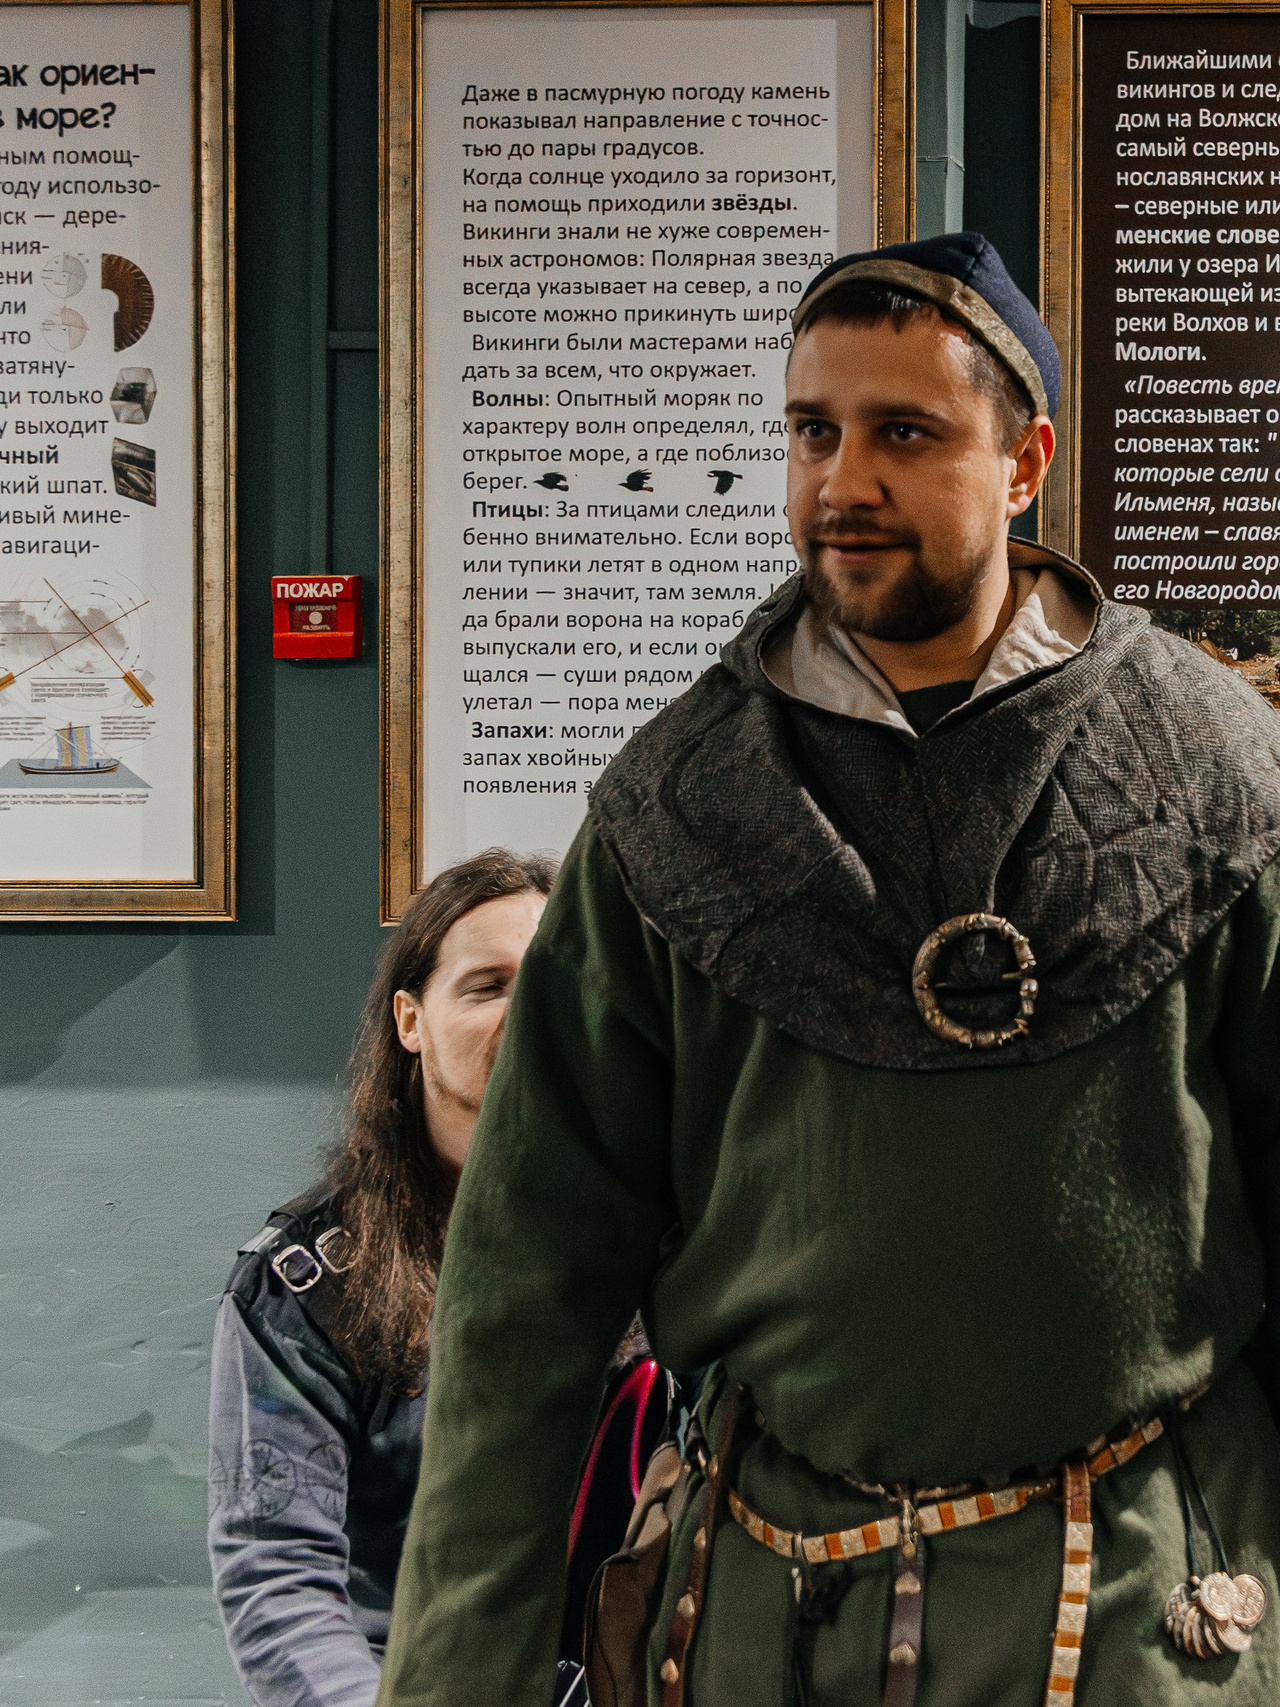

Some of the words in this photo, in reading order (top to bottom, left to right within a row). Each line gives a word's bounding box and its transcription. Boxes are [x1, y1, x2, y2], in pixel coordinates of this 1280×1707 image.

[1126, 48, 1272, 70] Ближайшими
[39, 63, 156, 96] ориен-
[460, 84, 521, 106] Даже
[526, 87, 539, 102] в
[544, 87, 666, 106] пасмурную
[672, 86, 746, 104] погоду
[751, 85, 831, 100] камень
[15, 101, 117, 138] море?
[462, 115, 577, 130] показывал
[583, 114, 726, 133] направление
[731, 114, 743, 128] с
[746, 113, 829, 128] точнос-
[1114, 112, 1161, 133] дом
[1166, 112, 1192, 128] на
[1115, 135, 1187, 158] самый
[52, 149, 141, 168] помощ-
[47, 179, 162, 195] использо-
[463, 167, 523, 190] Когда
[528, 170, 605, 189] солнце
[610, 170, 700, 189] уходило
[705, 170, 728, 184] за
[735, 169, 836, 188] горизонт,
[1116, 170, 1265, 187] нославянских
[462, 199, 487, 214] на
[494, 198, 582, 217] помощь
[588, 197, 706, 217] приходили
[711, 193, 798, 215] звёзды.
[61, 209, 127, 229] дере-
[463, 222, 551, 241] Викинги
[556, 225, 620, 240] знали
[626, 225, 652, 240] не
[657, 225, 711, 244] хуже
[716, 224, 831, 243] современ-
[1115, 228, 1212, 245] менские
[1114, 258, 1173, 274] жили
[1178, 258, 1192, 278] у
[1196, 257, 1259, 279] озера
[463, 281, 531, 299] всегда
[536, 280, 648, 300] указывает
[653, 280, 678, 295] на
[684, 280, 752, 299] север,
[758, 280, 770, 294] а
[776, 280, 803, 294] по
[1115, 281, 1254, 307] вытекающей
[1114, 341, 1207, 362] Мологи.
[1124, 374, 1234, 395] «Повесть
[26, 389, 104, 405] только
[472, 389, 550, 408] Волны:
[556, 387, 657, 407] Опытный
[663, 392, 732, 411] моряк
[737, 392, 764, 407] по
[14, 419, 110, 439] выходит
[1114, 408, 1262, 429] рассказывает
[47, 479, 108, 495] шпат.
[462, 470, 528, 494] берег.
[472, 500, 550, 522] Птицы:
[555, 500, 580, 518] За
[586, 504, 679, 522] птицами
[685, 504, 776, 522] следили
[1113, 491, 1216, 516] Ильменя,
[62, 509, 131, 525] мине-
[1113, 554, 1237, 575] построили
[276, 583, 344, 599] ПОЖАР
[1113, 583, 1150, 600] его
[471, 721, 554, 739] Запахи:
[560, 725, 625, 739] могли
